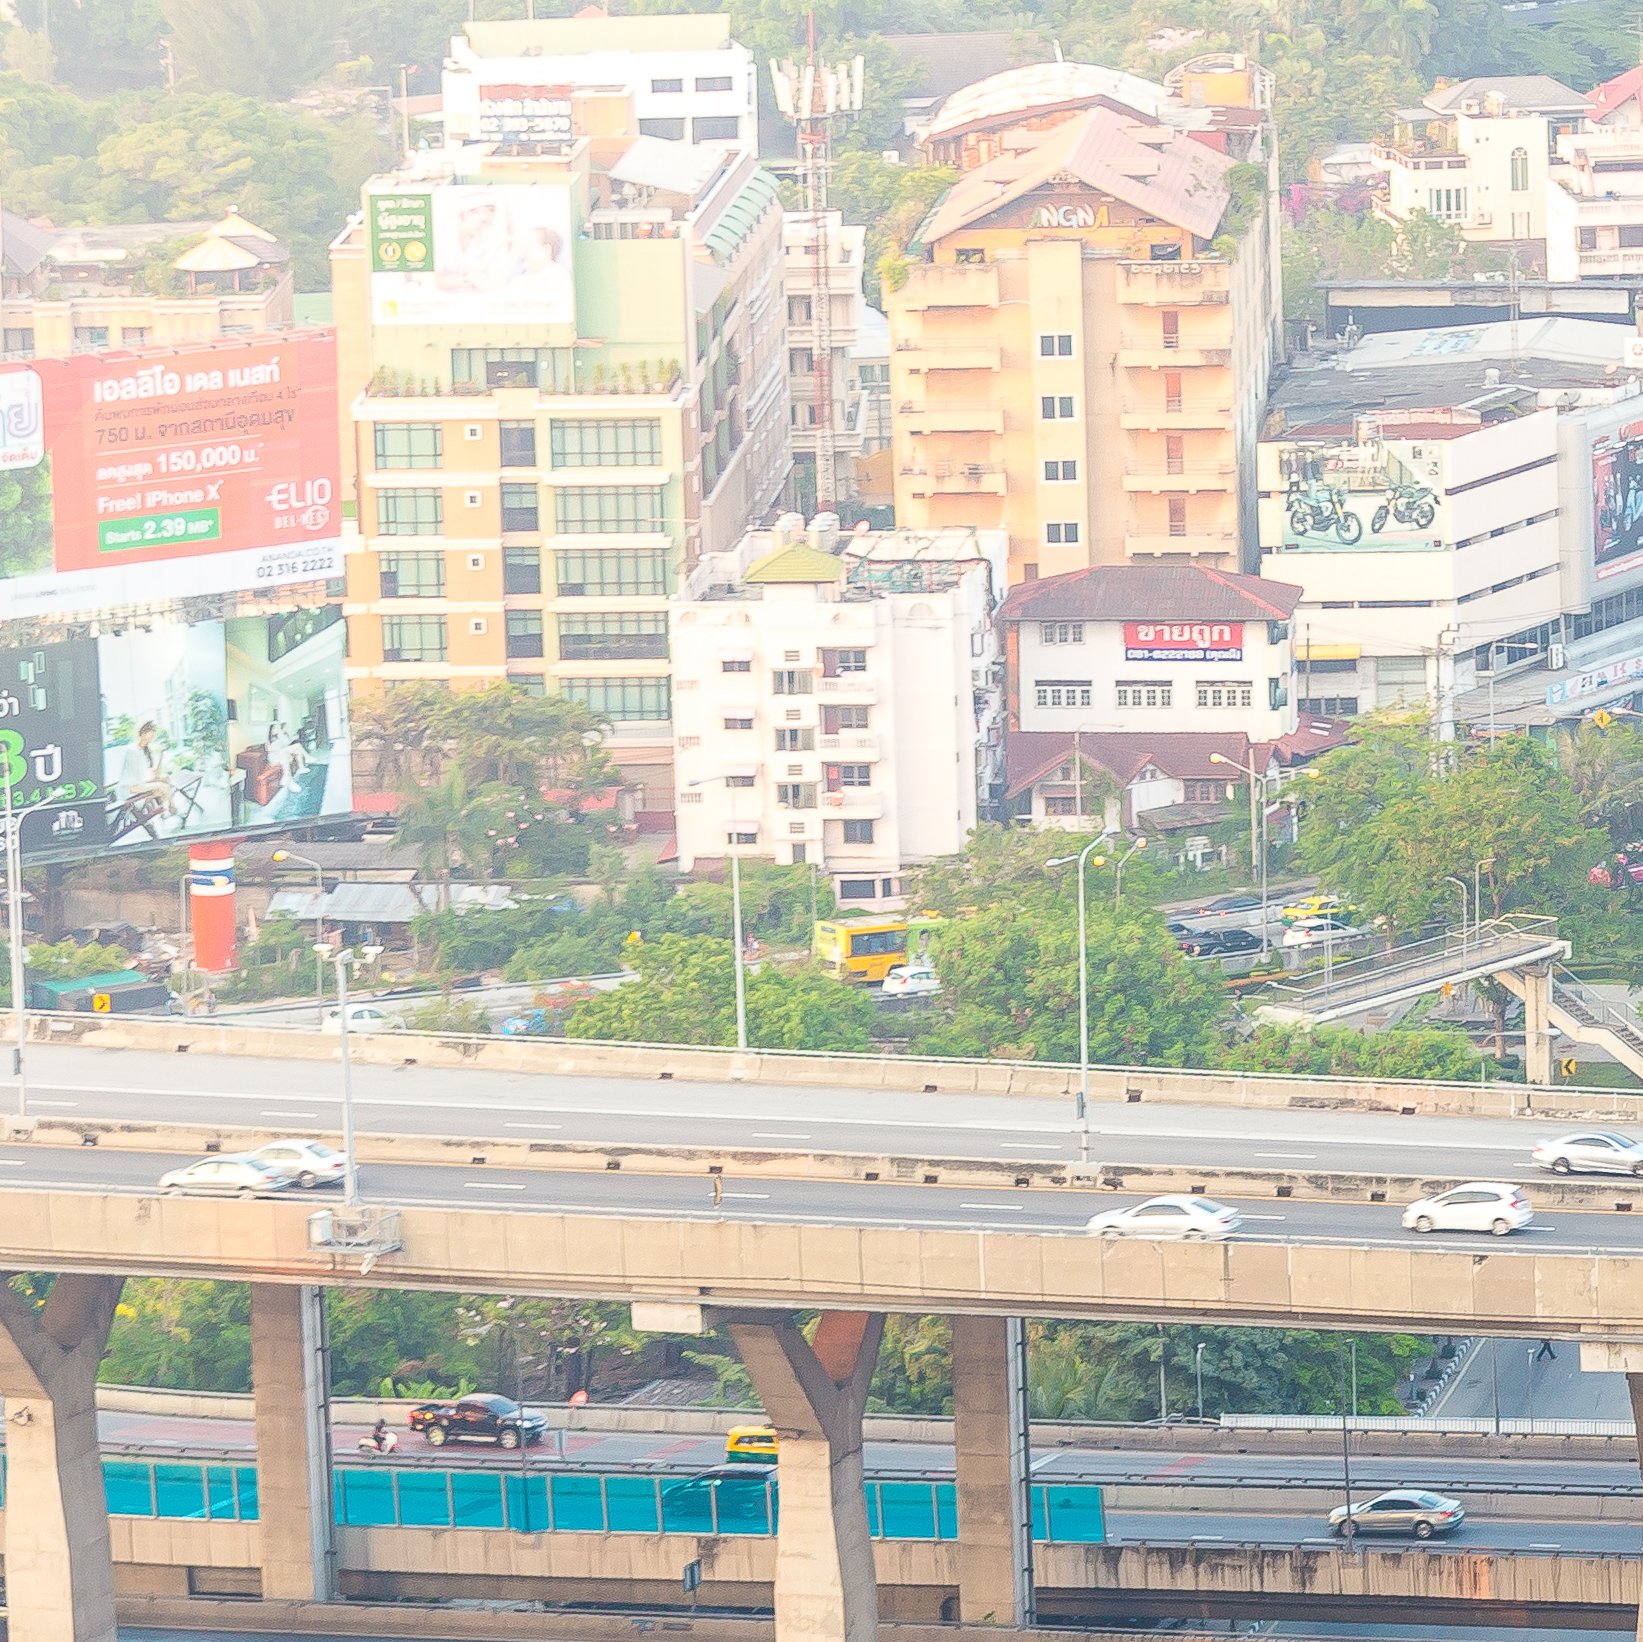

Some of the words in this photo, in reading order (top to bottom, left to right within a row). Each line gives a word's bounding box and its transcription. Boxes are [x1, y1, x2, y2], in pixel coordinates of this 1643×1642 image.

[96, 426, 129, 445] 750
[158, 407, 295, 437] จากสถานีอุดมสุข
[157, 444, 242, 475] 150,000
[97, 491, 143, 514] Free!
[146, 484, 206, 508] iPhone
[265, 478, 332, 511] ELIO
[143, 517, 186, 540] 2.39
[256, 565, 274, 579] 02
[301, 556, 334, 574] 2222
[1136, 624, 1232, 649] ขายถูก
[29, 743, 63, 783] ปี
